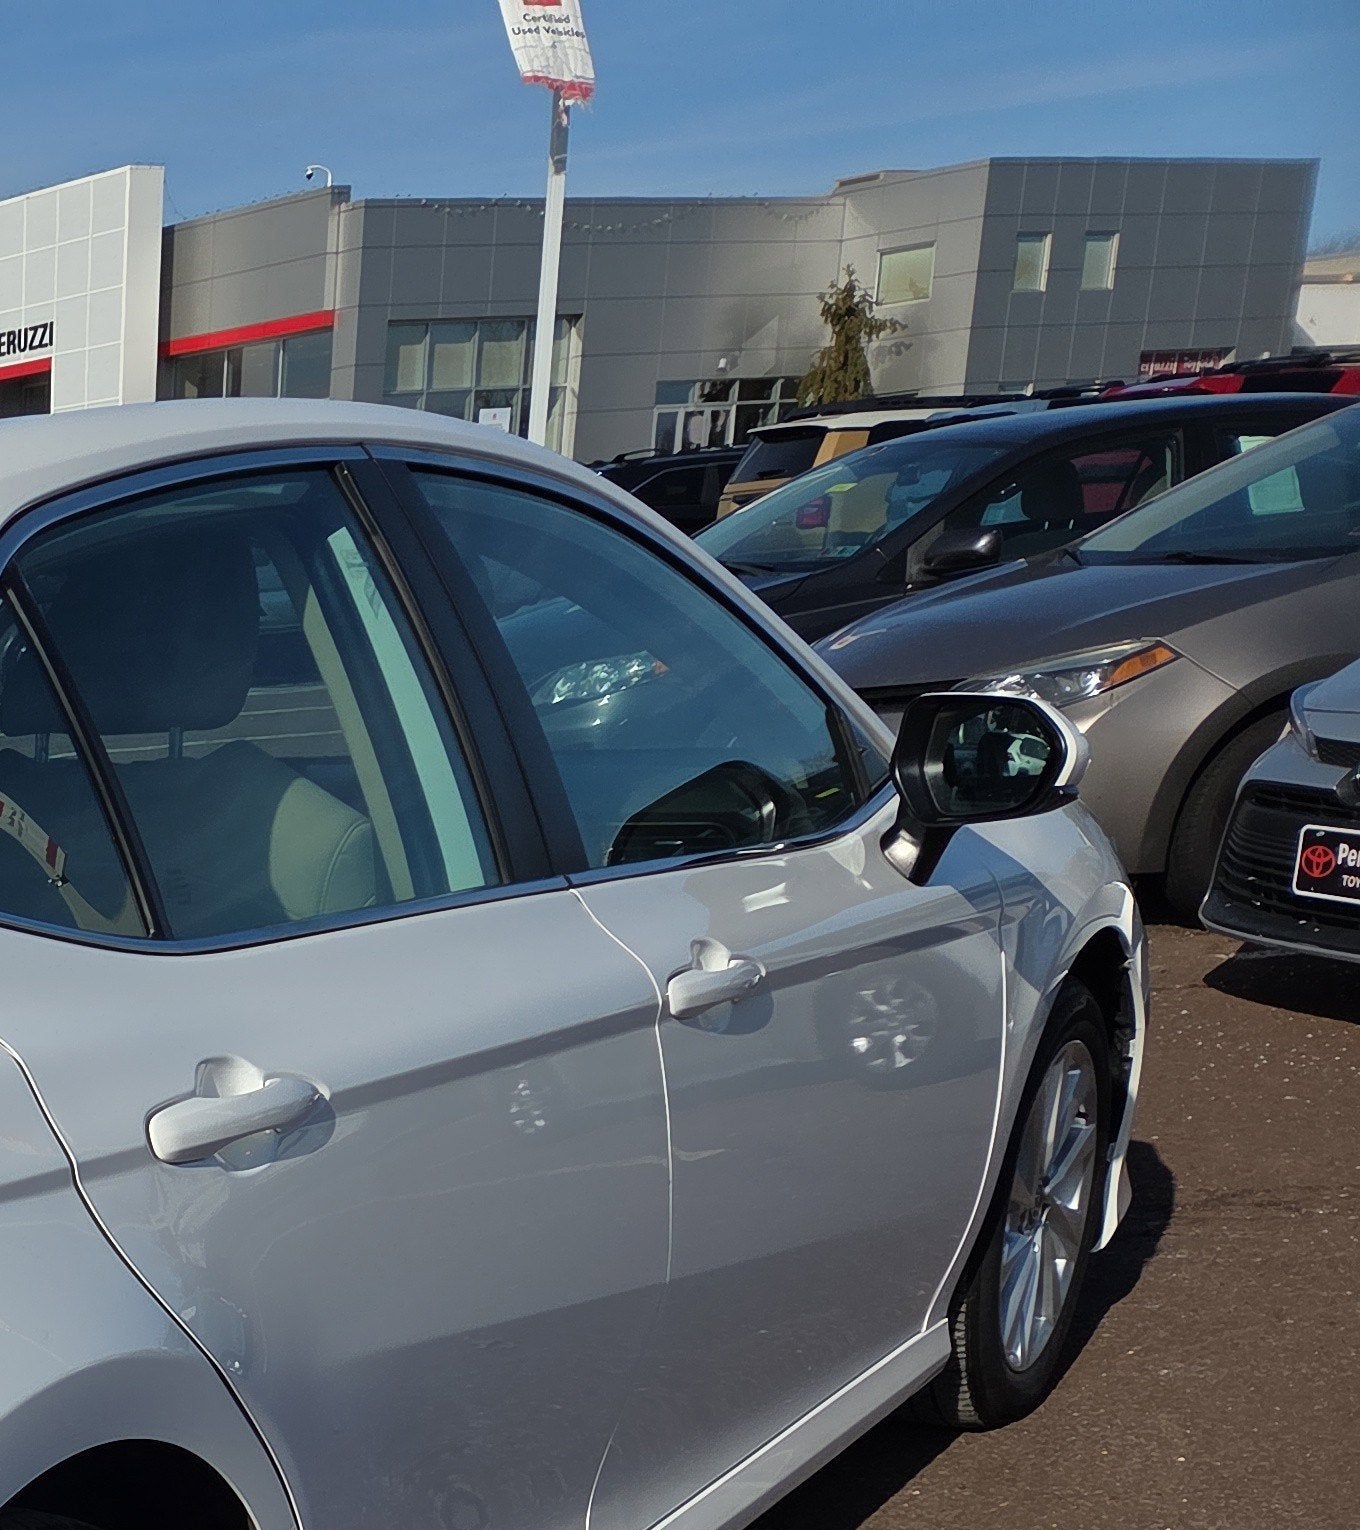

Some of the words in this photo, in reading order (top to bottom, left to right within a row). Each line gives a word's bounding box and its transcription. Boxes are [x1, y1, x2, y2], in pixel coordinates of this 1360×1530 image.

[523, 13, 570, 23] Certified
[511, 26, 540, 35] Used
[543, 26, 585, 39] Vehicles
[1337, 842, 1360, 868] Pe
